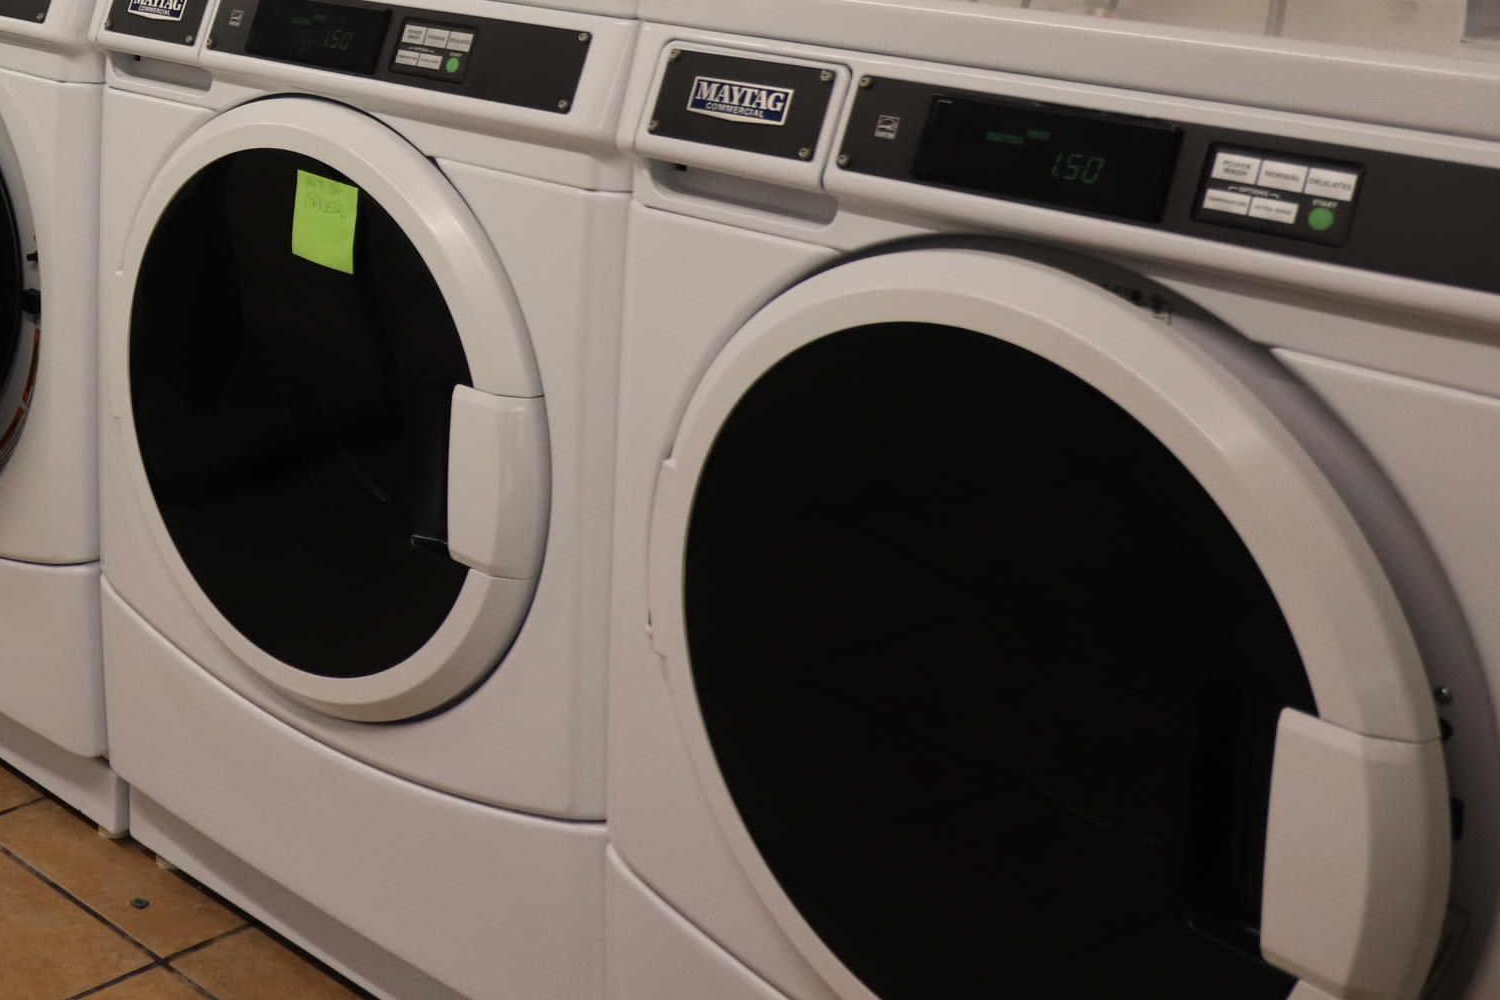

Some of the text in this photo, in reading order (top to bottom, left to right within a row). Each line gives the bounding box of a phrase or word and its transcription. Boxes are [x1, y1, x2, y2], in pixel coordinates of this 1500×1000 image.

[138, 5, 171, 16] COMMERCIAL
[694, 81, 786, 112] MAYTAG
[705, 101, 764, 118] COMMERCIAL
[1222, 159, 1252, 170] POWER
[1222, 167, 1248, 177] WASH
[1264, 170, 1300, 183] NORMAL
[1308, 177, 1352, 192] DELICATES
[1312, 198, 1338, 209] START
